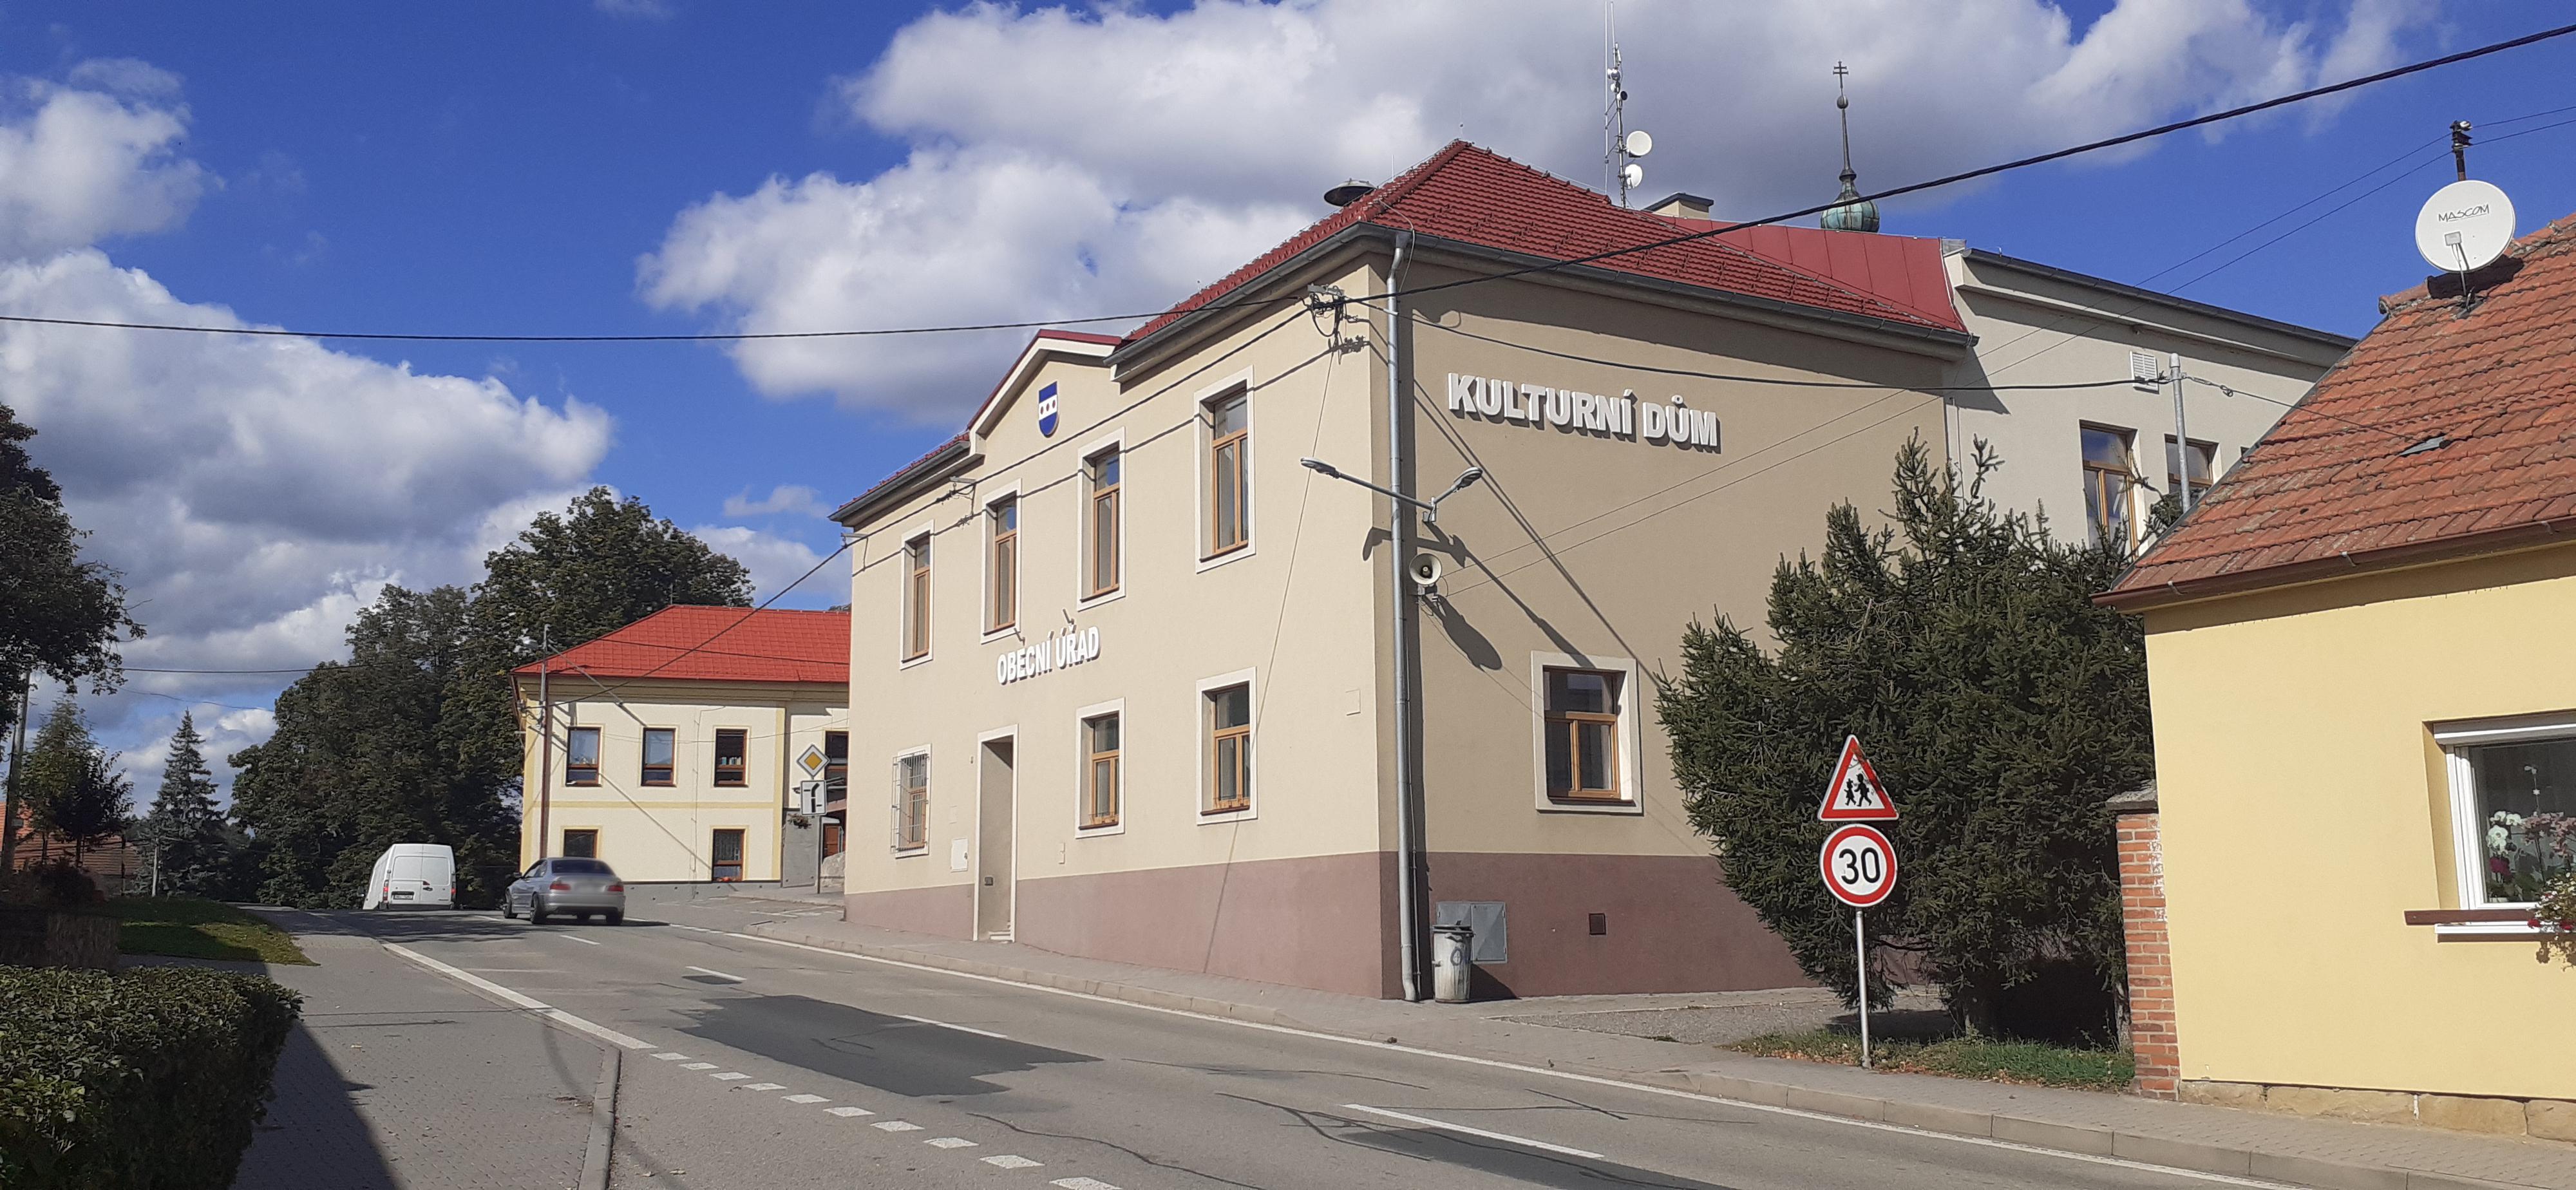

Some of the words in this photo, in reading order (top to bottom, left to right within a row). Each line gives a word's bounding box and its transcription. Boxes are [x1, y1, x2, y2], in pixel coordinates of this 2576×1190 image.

[2438, 204, 2490, 222] MASCOM
[1448, 372, 1634, 435] KULTURNÍ
[1642, 395, 1718, 447] DŮM
[997, 631, 1052, 684] OBECNÍ
[1056, 624, 1100, 668] ÚŘAD
[1839, 847, 1881, 885] 30
